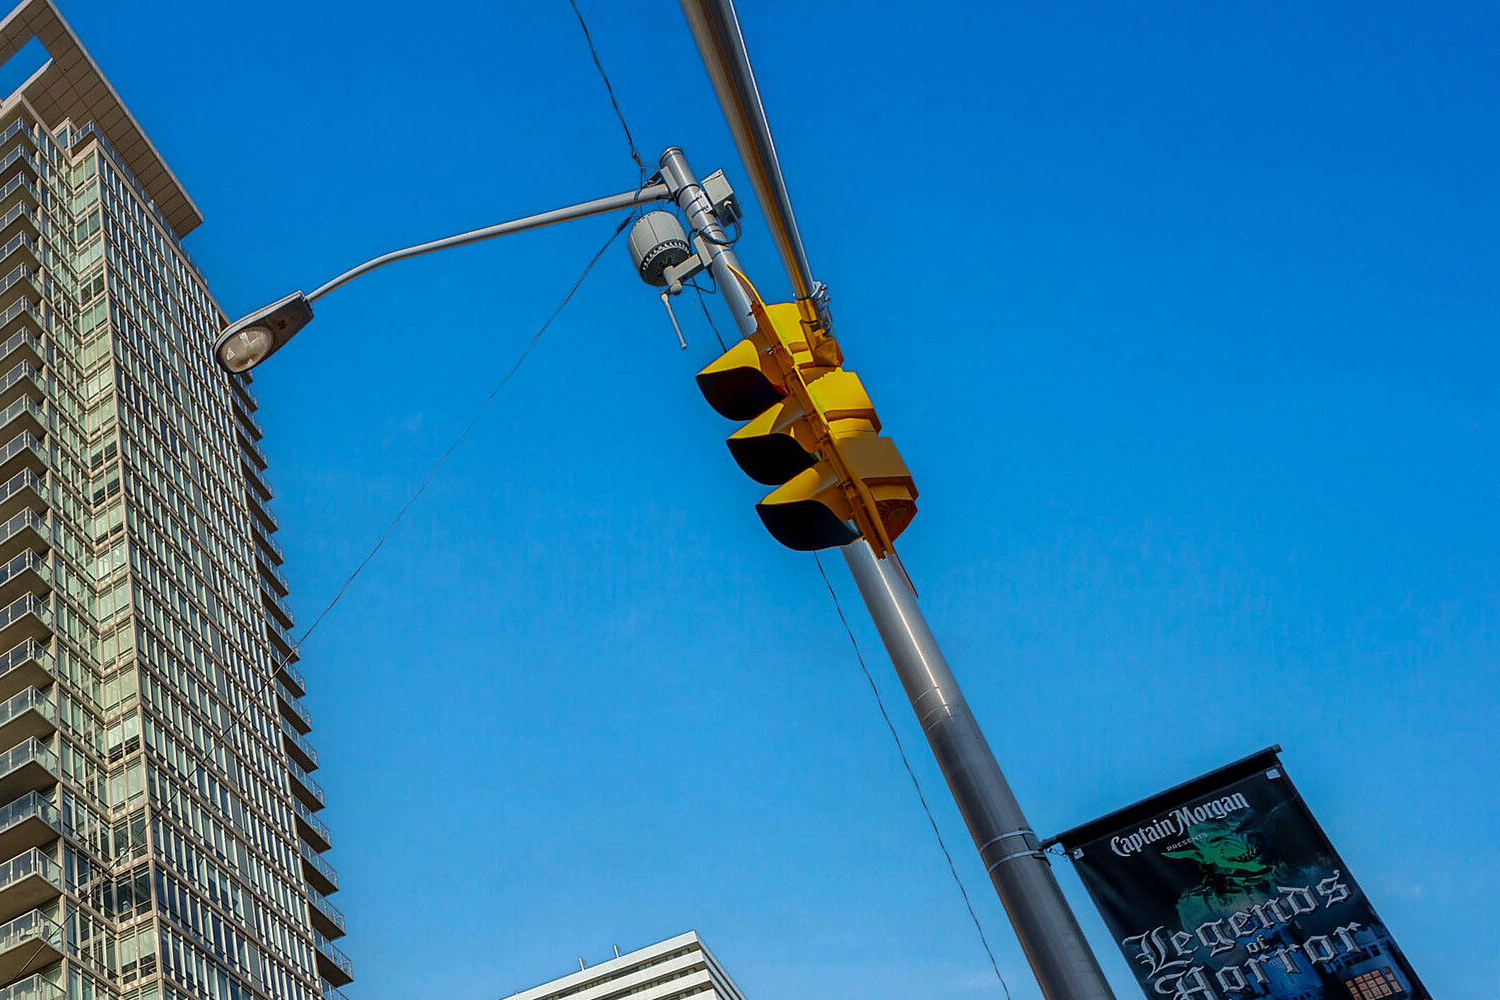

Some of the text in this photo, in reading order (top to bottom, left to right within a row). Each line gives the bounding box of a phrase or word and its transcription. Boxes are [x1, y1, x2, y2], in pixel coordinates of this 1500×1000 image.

[1110, 792, 1250, 857] Captain Morgan
[1166, 832, 1208, 852] PRESENTS
[1122, 869, 1351, 979] Legends
